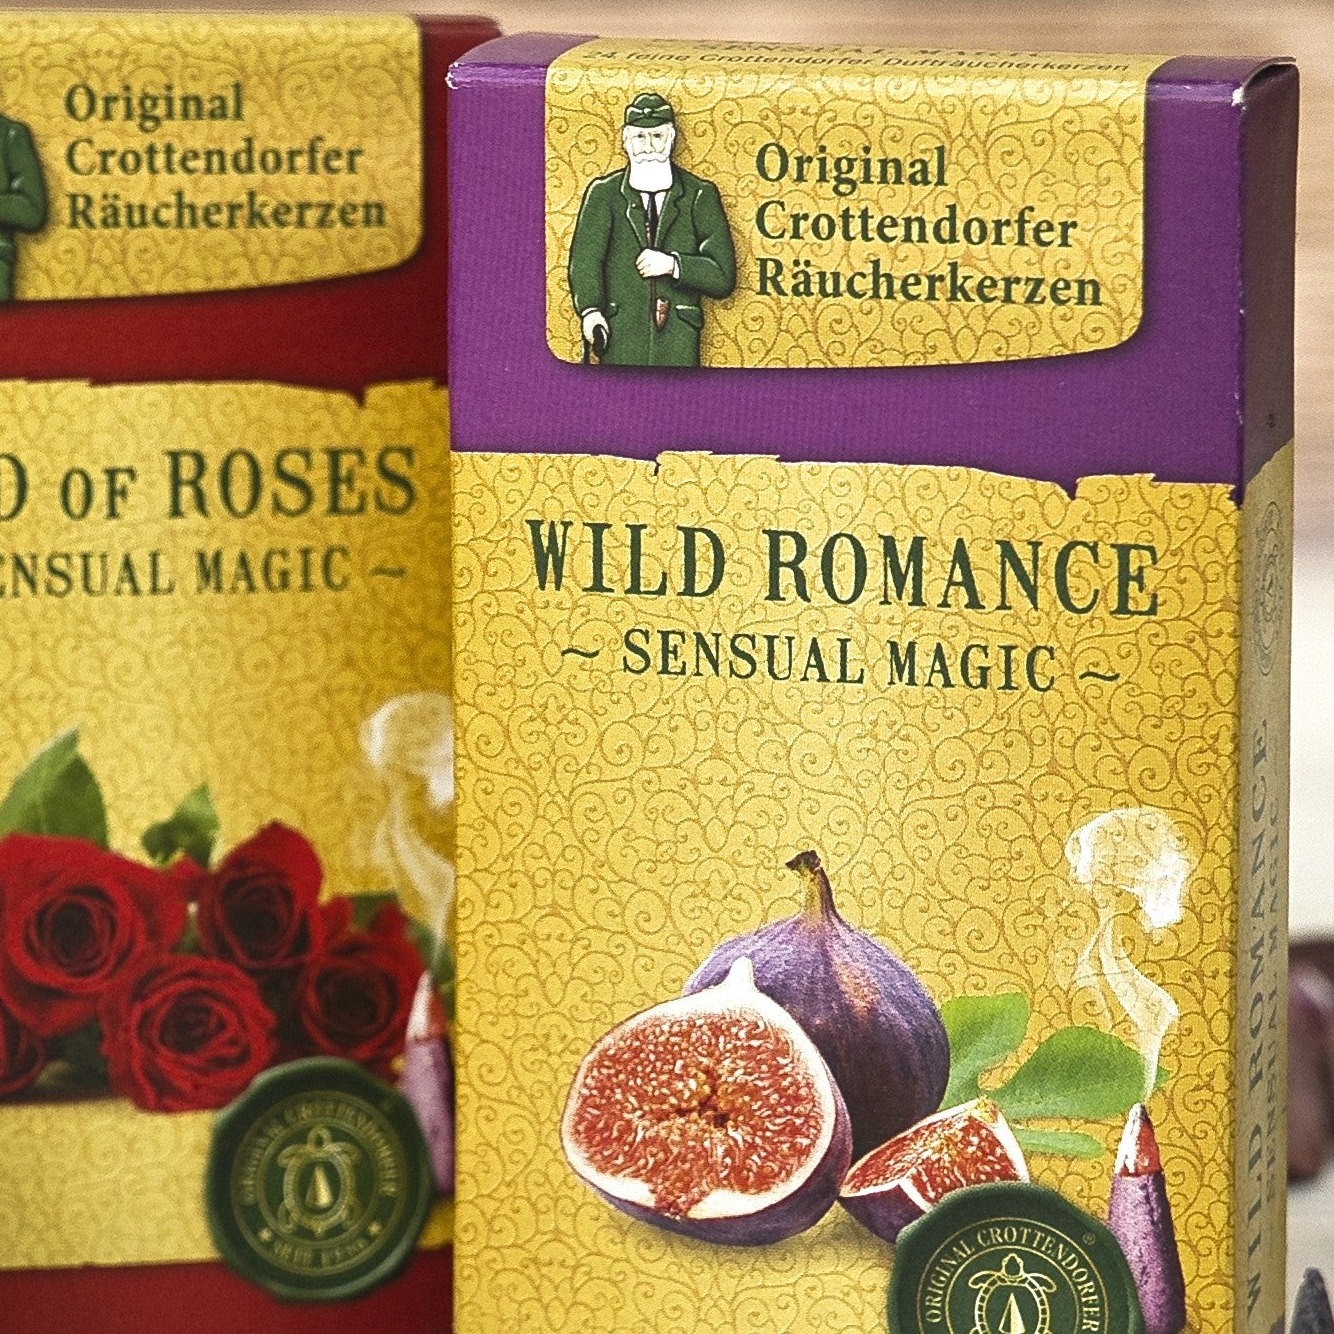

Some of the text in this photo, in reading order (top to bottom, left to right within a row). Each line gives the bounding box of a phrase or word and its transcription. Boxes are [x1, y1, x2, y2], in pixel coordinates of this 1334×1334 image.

[626, 51, 691, 62] feine
[699, 53, 871, 66] Crottendorfer
[883, 56, 1130, 72] Dufträucherkerzen
[66, 82, 245, 128] Original
[66, 137, 365, 177] Crottendorfer
[754, 143, 948, 195] Original
[67, 191, 386, 231] Räucherkerzen
[754, 199, 1079, 249] Crottendorfer
[755, 256, 1103, 307] Räucherkerzen
[59, 466, 138, 521] OF
[164, 445, 419, 521] ROSES
[194, 545, 352, 595] MAGIC
[525, 518, 726, 598] WILD
[764, 527, 1160, 617] ROMANCE
[623, 627, 1058, 693] SENSUAL MAGIC
[1246, 718, 1268, 1321] WILD ROMANCE
[1265, 793, 1280, 1205] SENSUAL MAGIC
[925, 1225, 1100, 1333] ORIGINAL CROTTENDORFER
